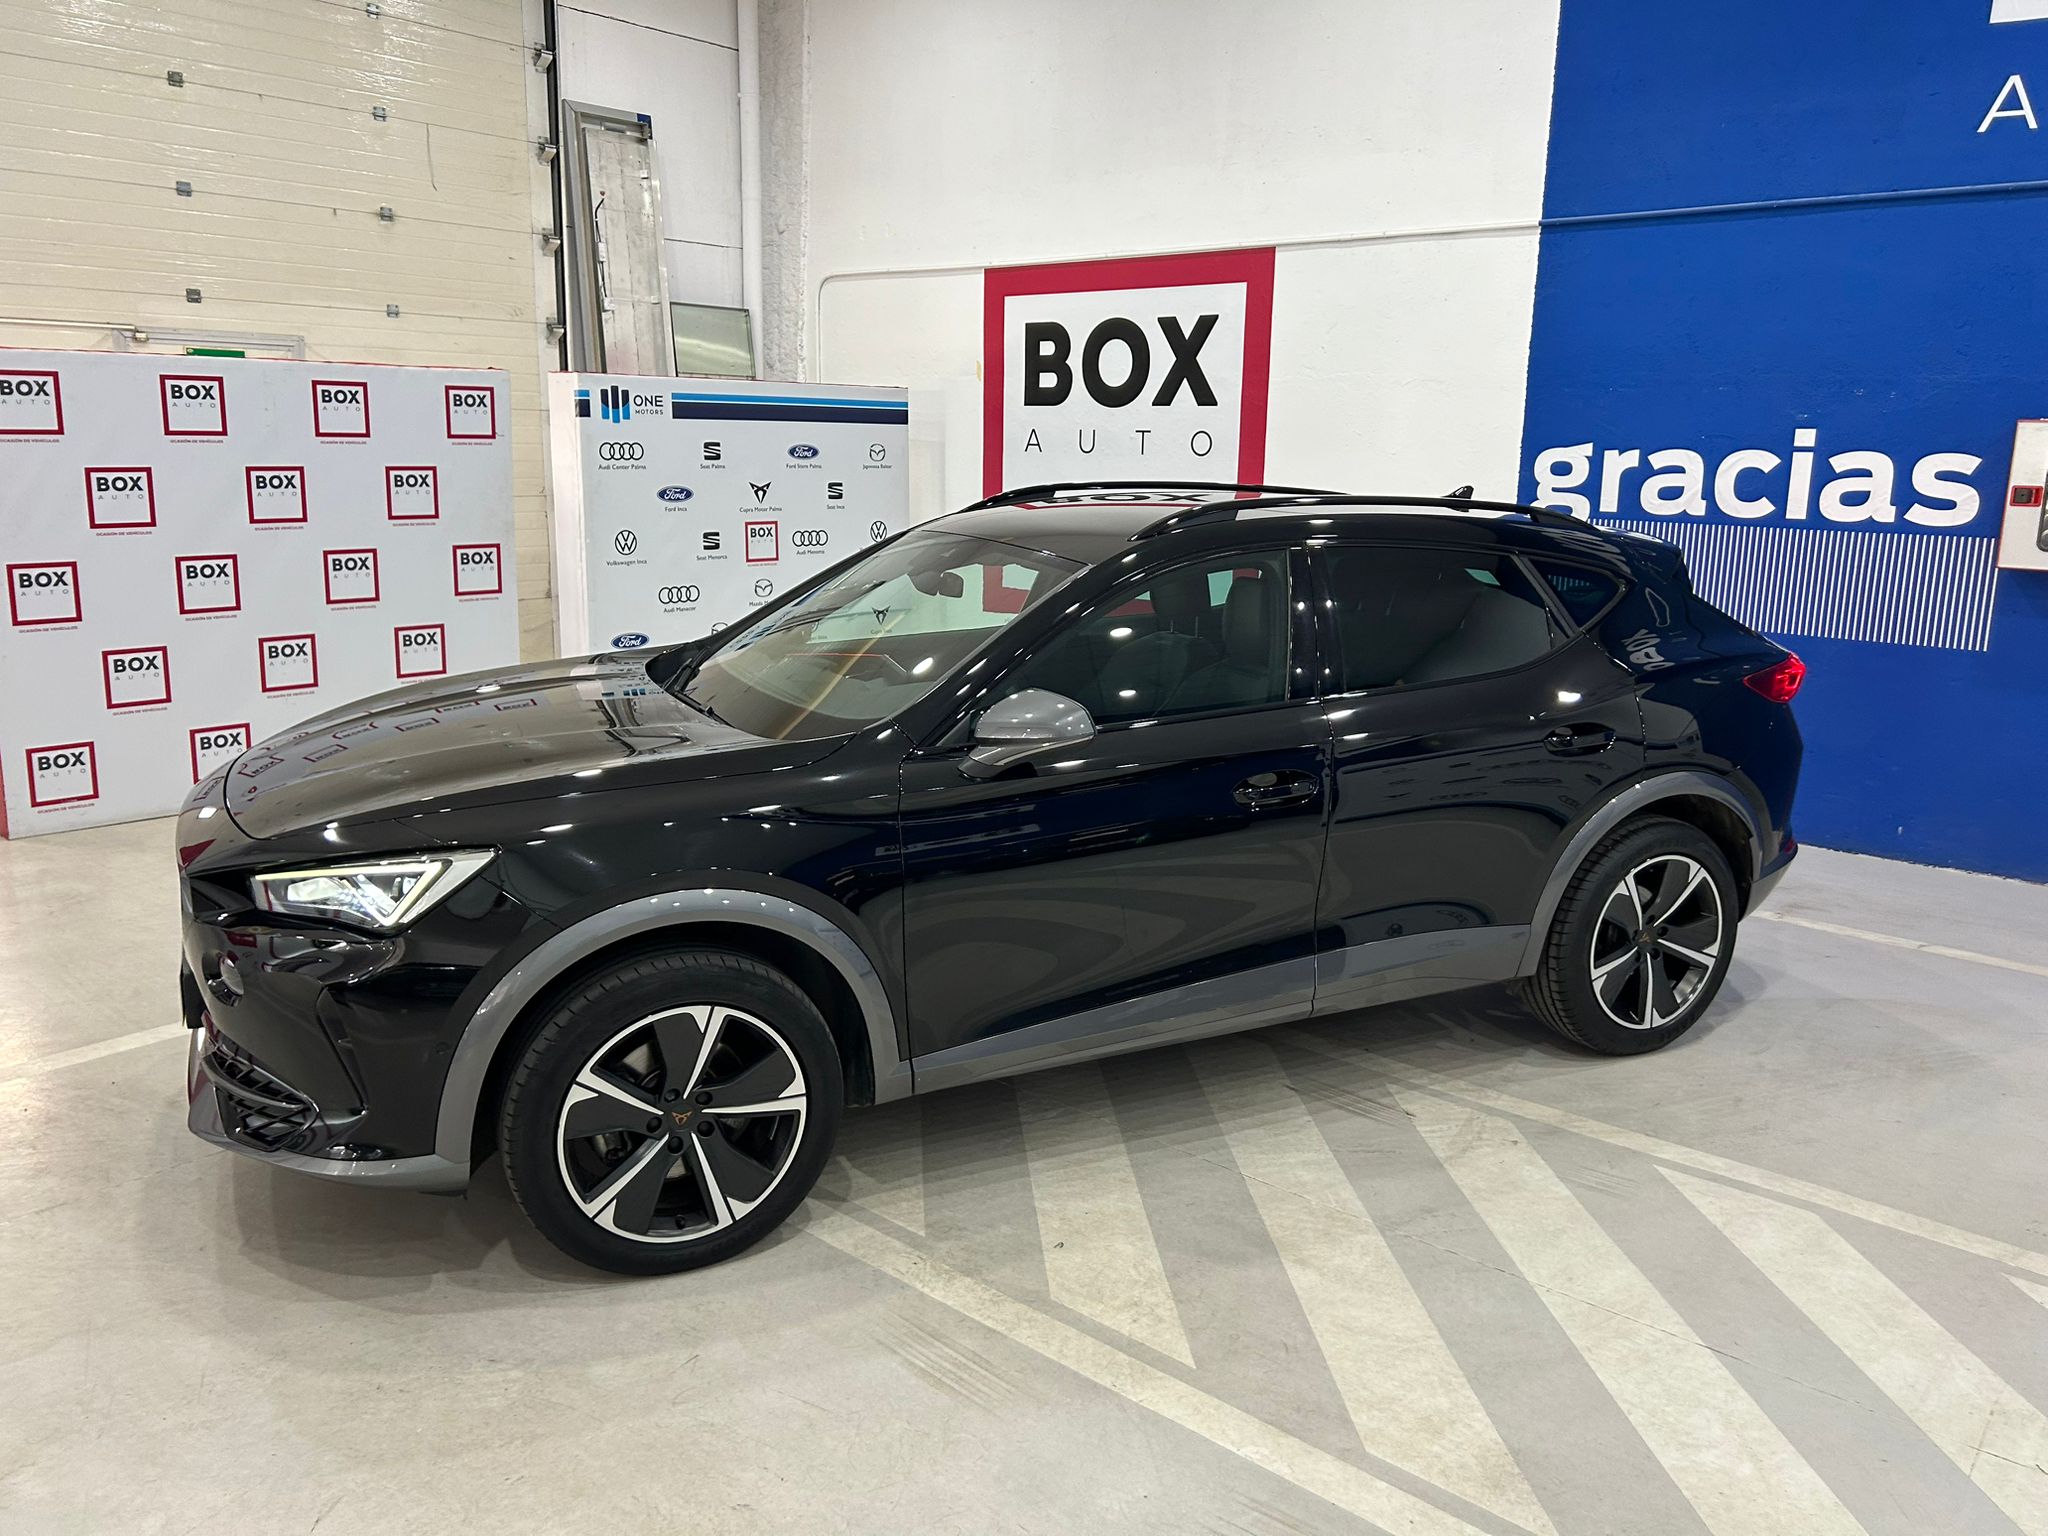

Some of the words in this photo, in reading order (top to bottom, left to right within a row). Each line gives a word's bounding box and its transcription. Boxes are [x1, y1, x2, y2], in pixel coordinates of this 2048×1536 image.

[1024, 314, 1219, 408] BOX
[0, 380, 50, 396] BOX
[170, 384, 216, 400] BOX
[321, 389, 360, 404] BOX
[453, 394, 488, 408] BOX
[633, 394, 664, 407] ONE
[1025, 428, 1213, 456] AUTO
[95, 476, 144, 492] BOX
[255, 475, 297, 489] BOX
[393, 474, 430, 488] BOX
[1530, 428, 1983, 527] gracias
[663, 488, 687, 500] Ford
[739, 506, 754, 514] Cupra
[750, 526, 774, 538] BOX
[332, 557, 370, 572] BOX
[460, 551, 494, 565] BOX
[606, 559, 636, 567] Volkswagen
[185, 563, 229, 580] BOX
[18, 571, 68, 588] BOX
[402, 632, 438, 647] BOX
[618, 635, 642, 648] Ford
[268, 643, 308, 659] BOX
[113, 655, 159, 673] BOX
[269, 658, 309, 666] AUTO
[114, 672, 160, 681] AUTO
[200, 732, 242, 751] BOX
[201, 747, 243, 758] AUTO
[37, 751, 86, 772] BOX
[40, 768, 87, 779] AUTO
